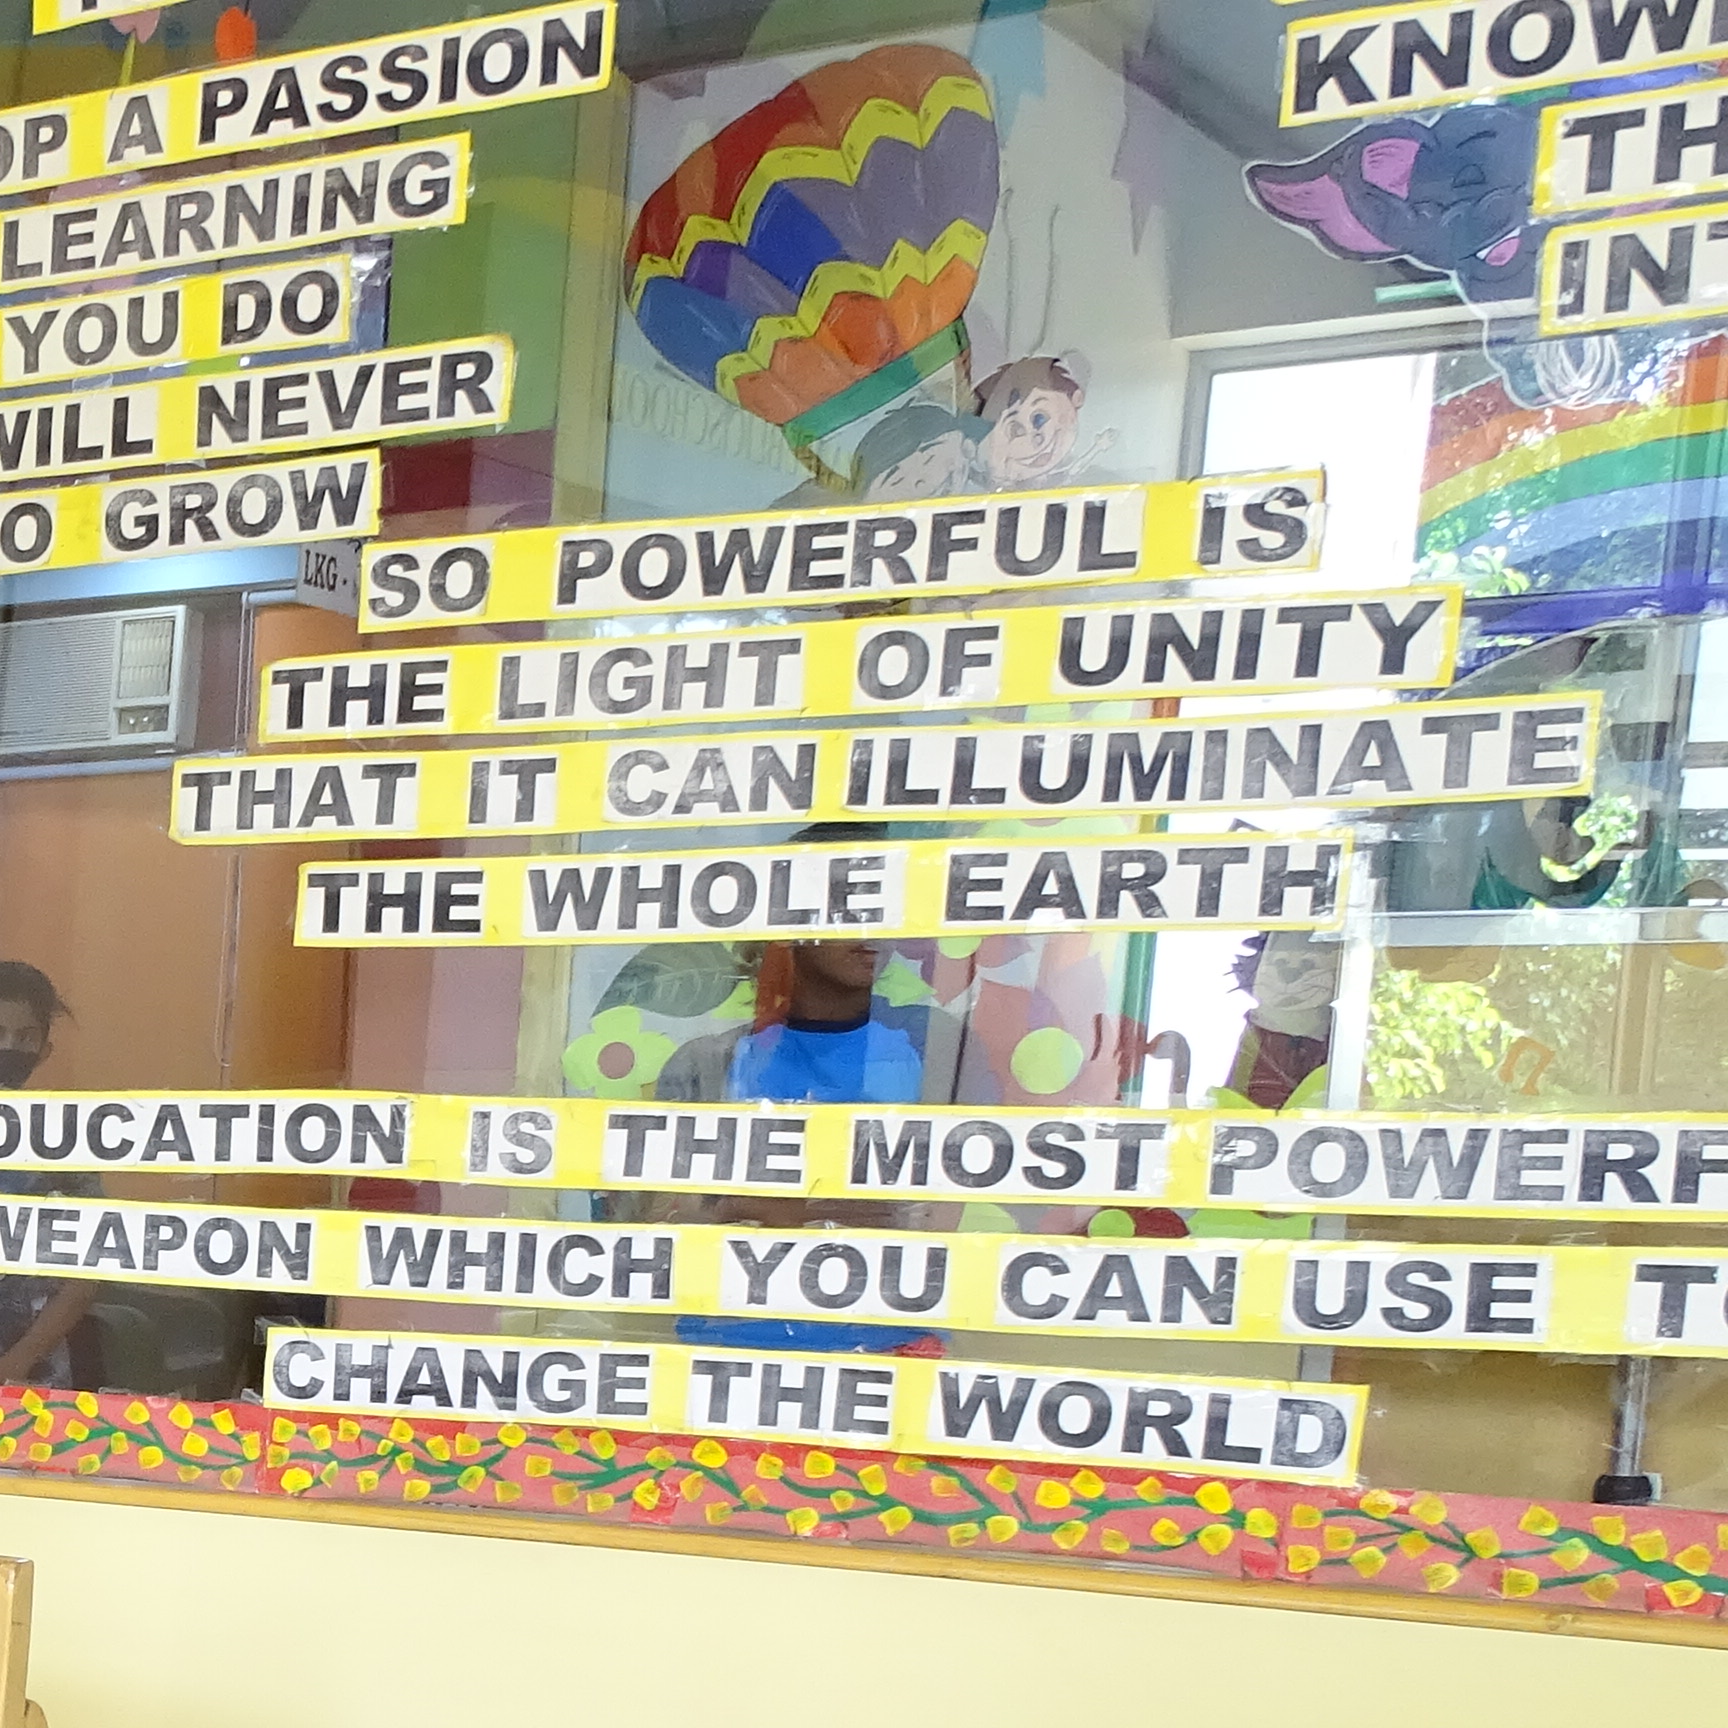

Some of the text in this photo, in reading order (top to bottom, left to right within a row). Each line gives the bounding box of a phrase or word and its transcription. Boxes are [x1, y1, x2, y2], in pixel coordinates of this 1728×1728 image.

[107, 95, 163, 162] A
[197, 10, 604, 143] PASSION
[1293, 0, 1728, 114] KNOW
[0, 150, 453, 282] LEARNING
[1557, 220, 1728, 318] IN
[8, 290, 181, 374] YOU
[220, 269, 339, 345] DO
[197, 350, 496, 448] NEVER
[104, 461, 366, 552] GROW
[368, 485, 1311, 618] SO POWERFUL IS
[271, 600, 1443, 731] THE LIGHT OF UNITY
[181, 707, 1586, 832] THAT IT CAN ILLUMINATE
[306, 843, 1342, 934] THE WHOLE EARTH
[469, 1109, 554, 1174] IS
[607, 1113, 805, 1184] THE
[851, 1118, 1166, 1191] MOST
[1210, 1125, 1728, 1203] POWERF
[365, 1225, 672, 1299] WHICH
[727, 1240, 947, 1312] YOU
[1000, 1251, 1237, 1324] CAN
[1290, 1258, 1538, 1334] USE
[1635, 1263, 1728, 1338] T
[271, 1340, 1347, 1467] CHANGE THE WORLD
